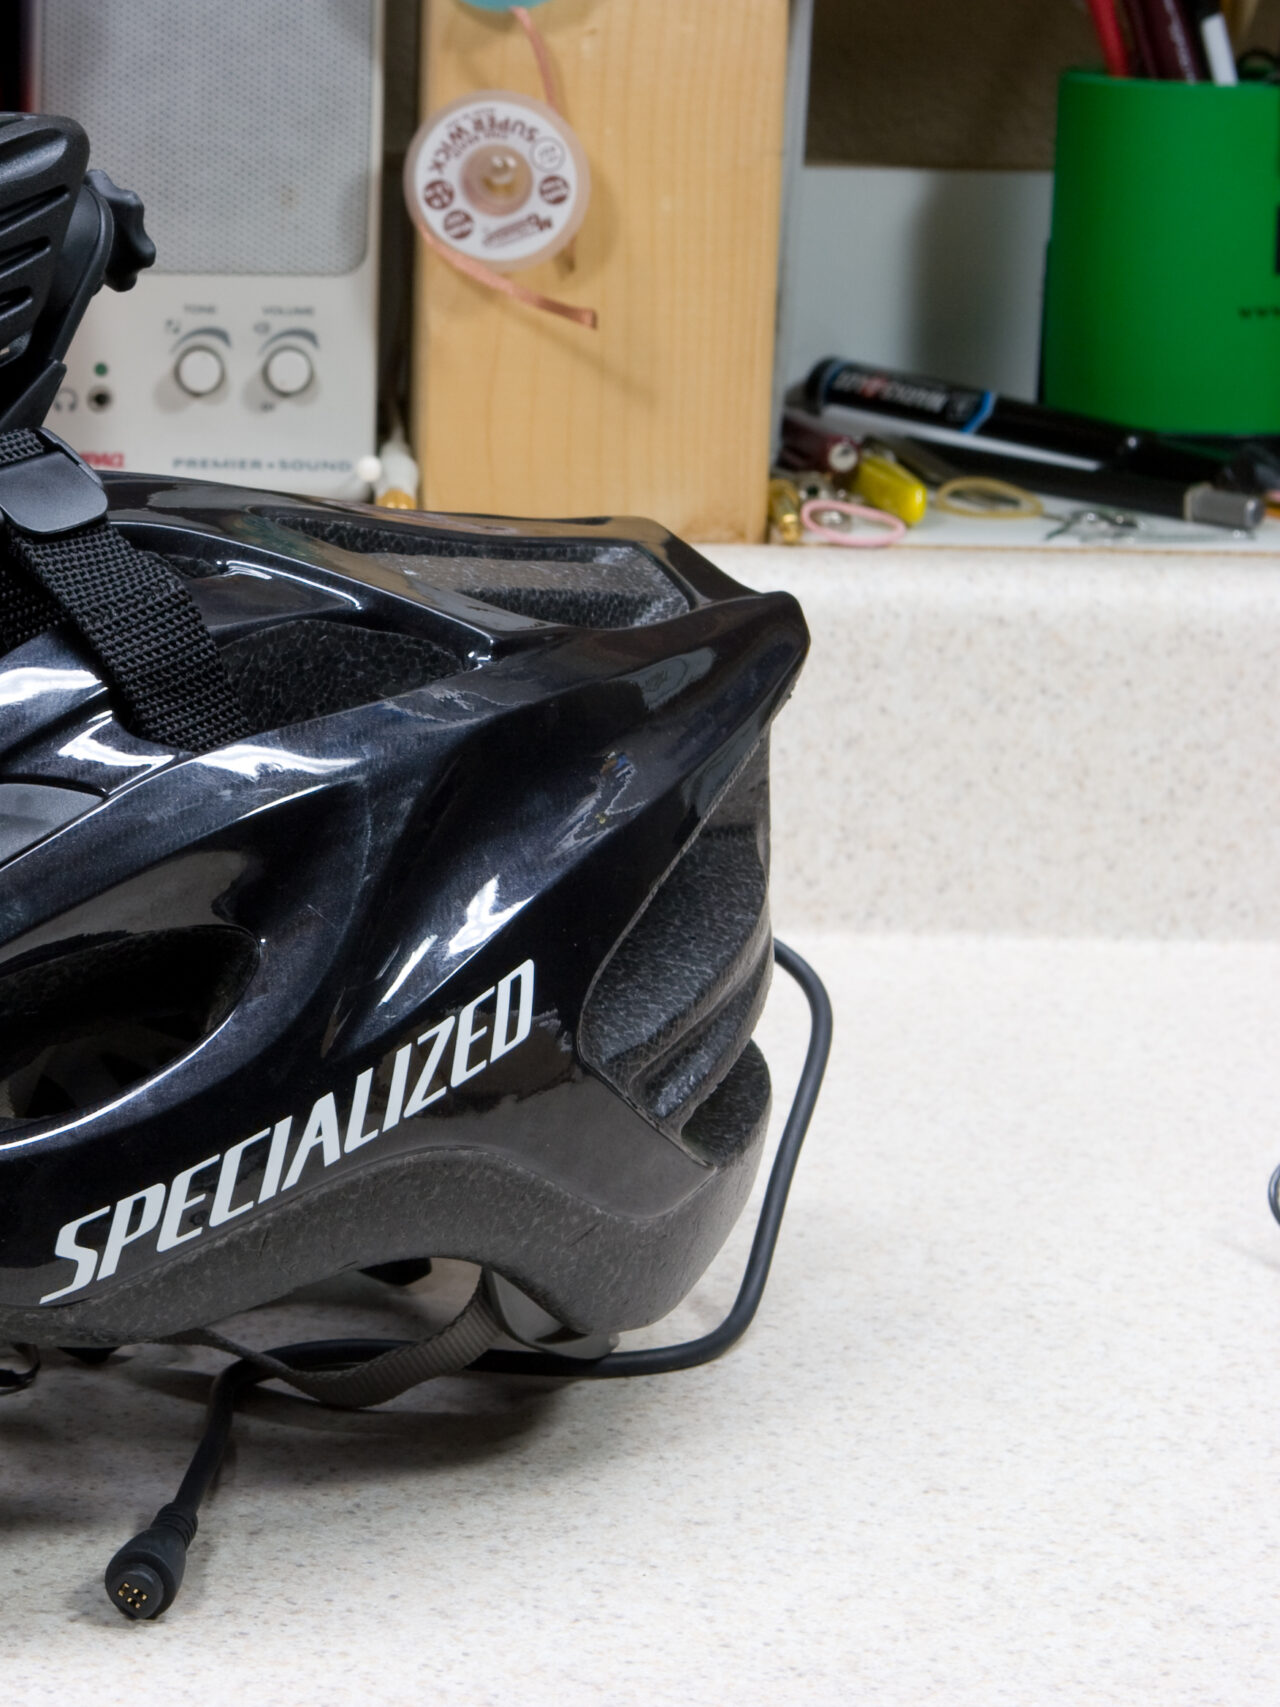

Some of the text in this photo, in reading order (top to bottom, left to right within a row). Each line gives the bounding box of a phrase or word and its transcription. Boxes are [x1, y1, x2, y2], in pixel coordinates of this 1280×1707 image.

[471, 114, 539, 143] SUPER
[429, 124, 470, 175] WICK
[183, 303, 216, 315] TONE
[261, 305, 316, 317] VOLUME
[172, 456, 353, 473] PREMIER SOUND
[39, 959, 535, 1304] SPECIALIZED
